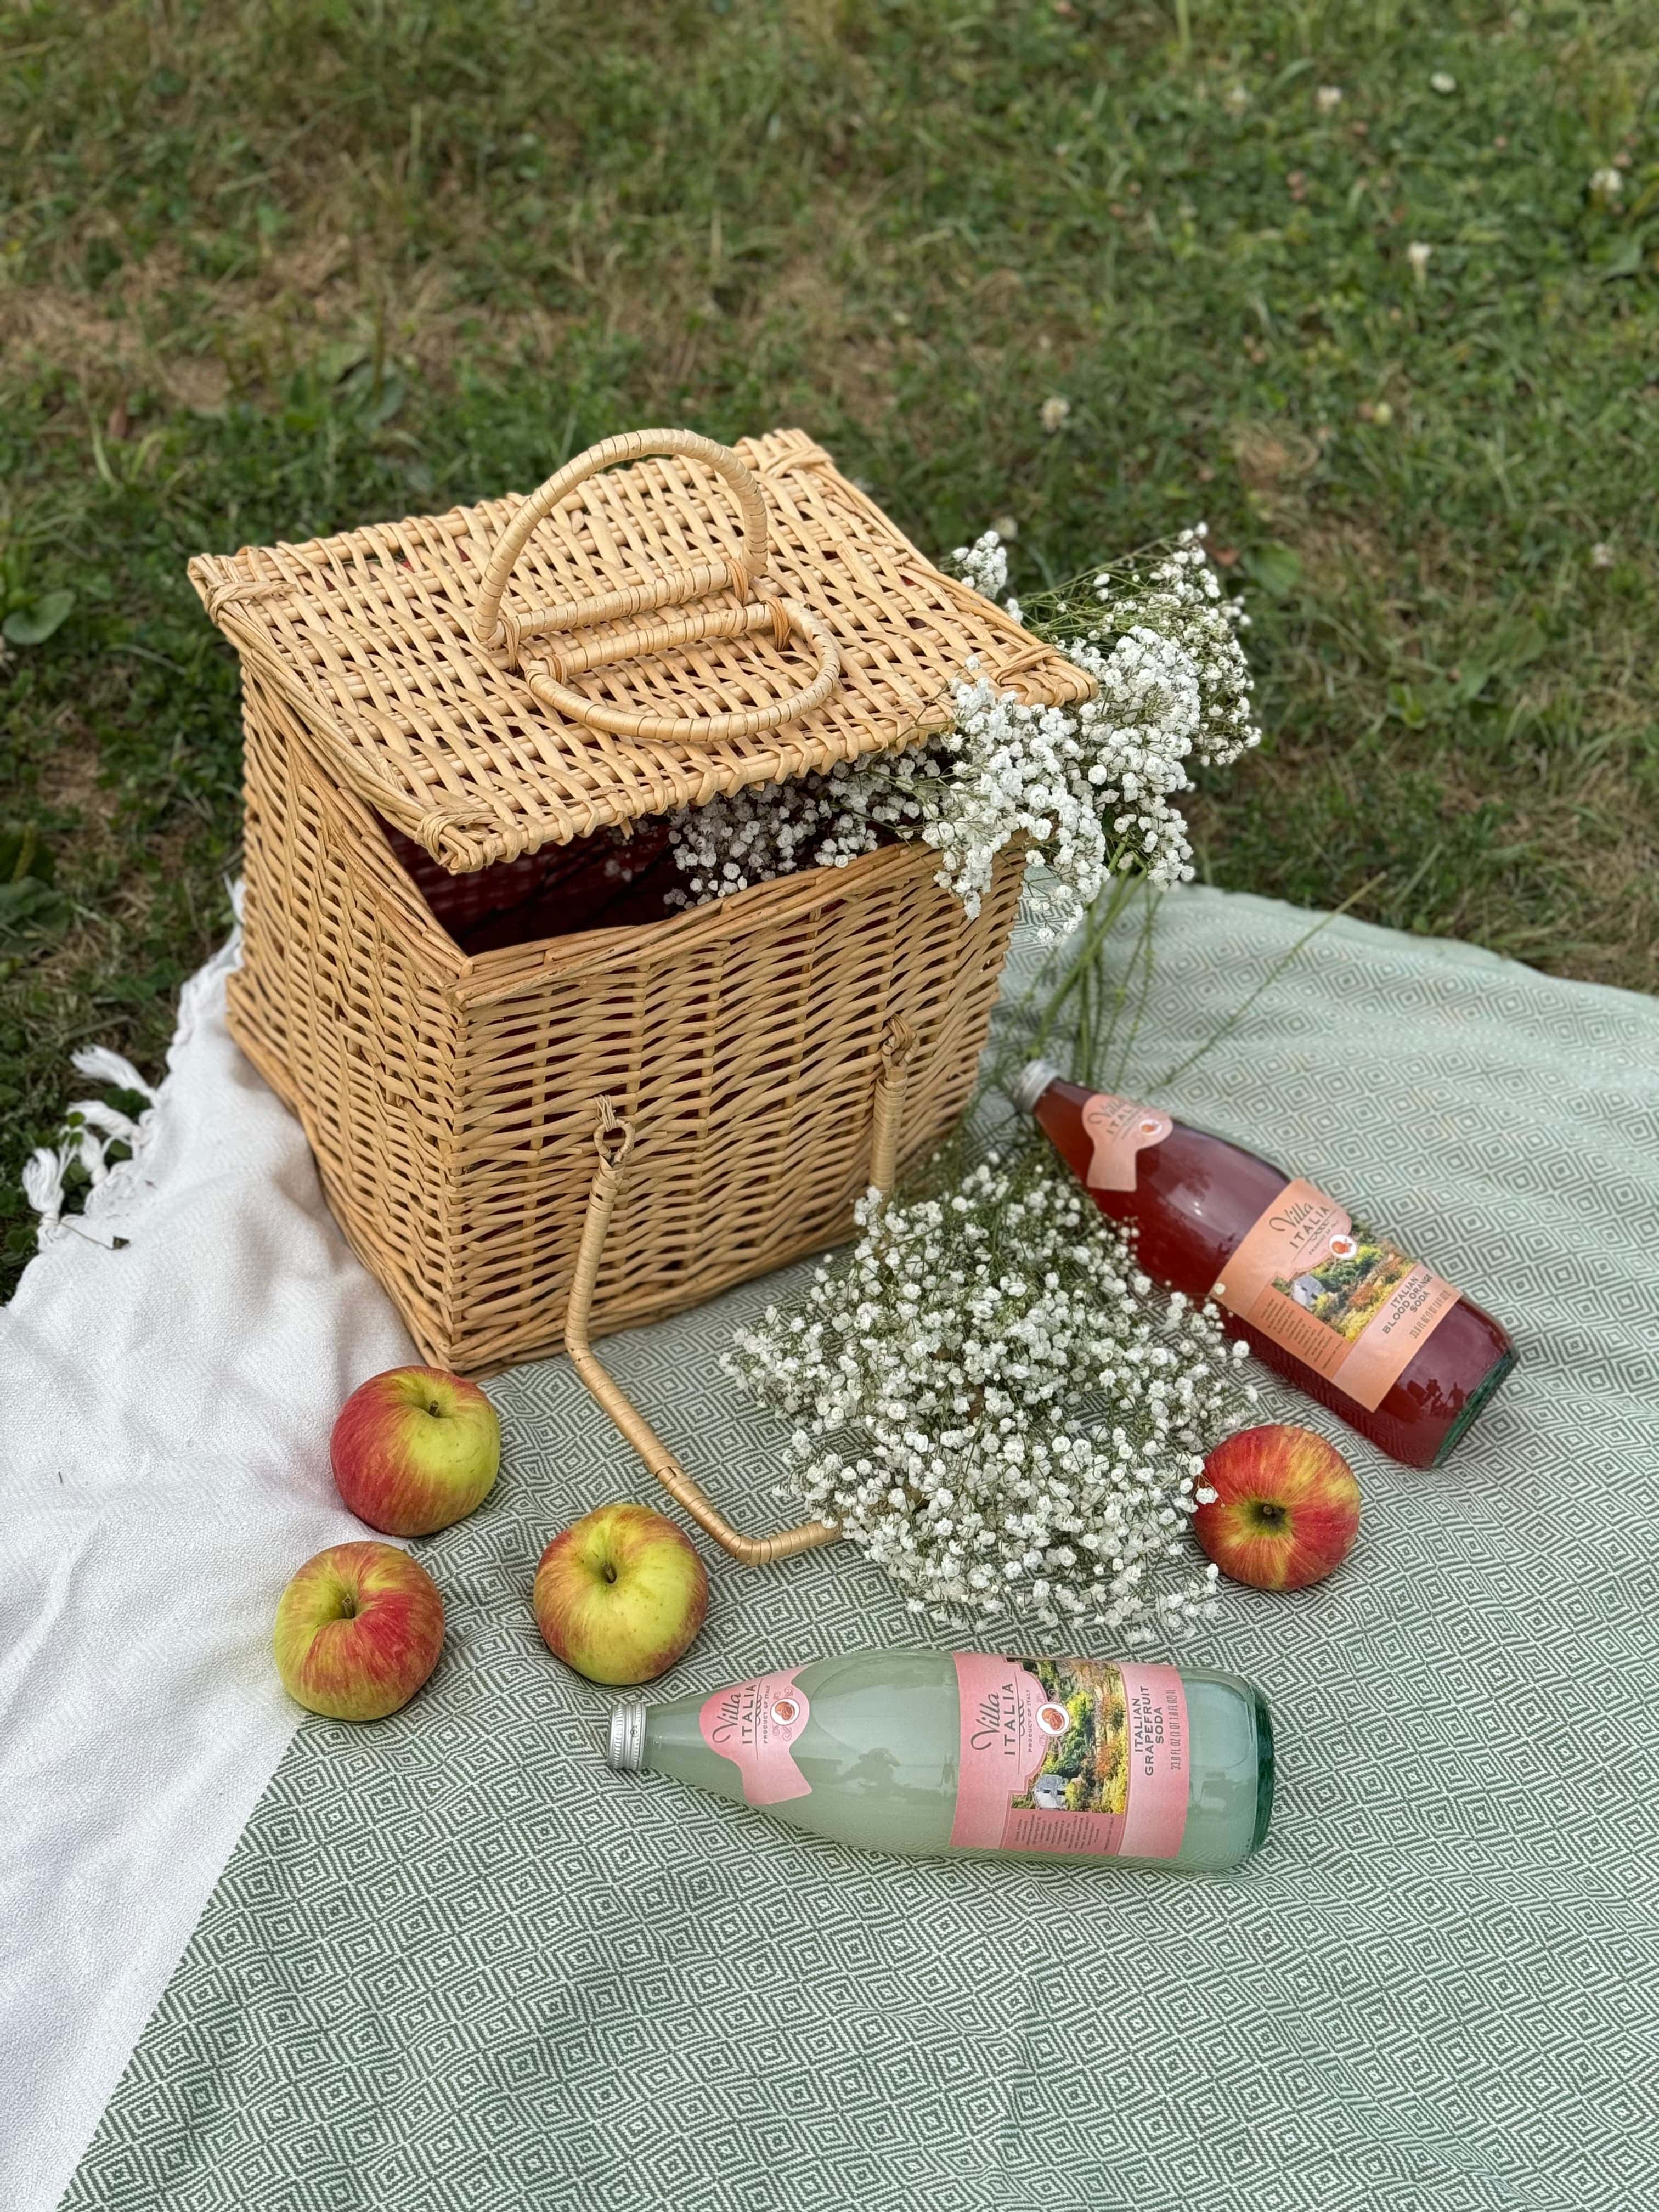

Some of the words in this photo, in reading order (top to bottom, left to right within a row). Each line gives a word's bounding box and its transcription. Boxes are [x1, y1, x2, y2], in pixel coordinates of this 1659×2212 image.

[1269, 1203, 1314, 1232] Villa
[1289, 1206, 1330, 1249] ITALIA
[1381, 1300, 1410, 1334] BLOOD
[1409, 1273, 1433, 1300] ORANGE
[1390, 1276, 1419, 1308] ITALIAN
[1410, 1290, 1431, 1313] SODA
[712, 1692, 741, 1743] Villa
[742, 1684, 757, 1744] ITALIA
[970, 1692, 1000, 1750] Villa
[1002, 1683, 1015, 1755] ITALIA
[1132, 1698, 1143, 1752] ITALIAN
[1140, 1685, 1154, 1776] GRAPEFRUIT
[1154, 1707, 1164, 1744] SODA
[1170, 1737, 1181, 1746] OZ
